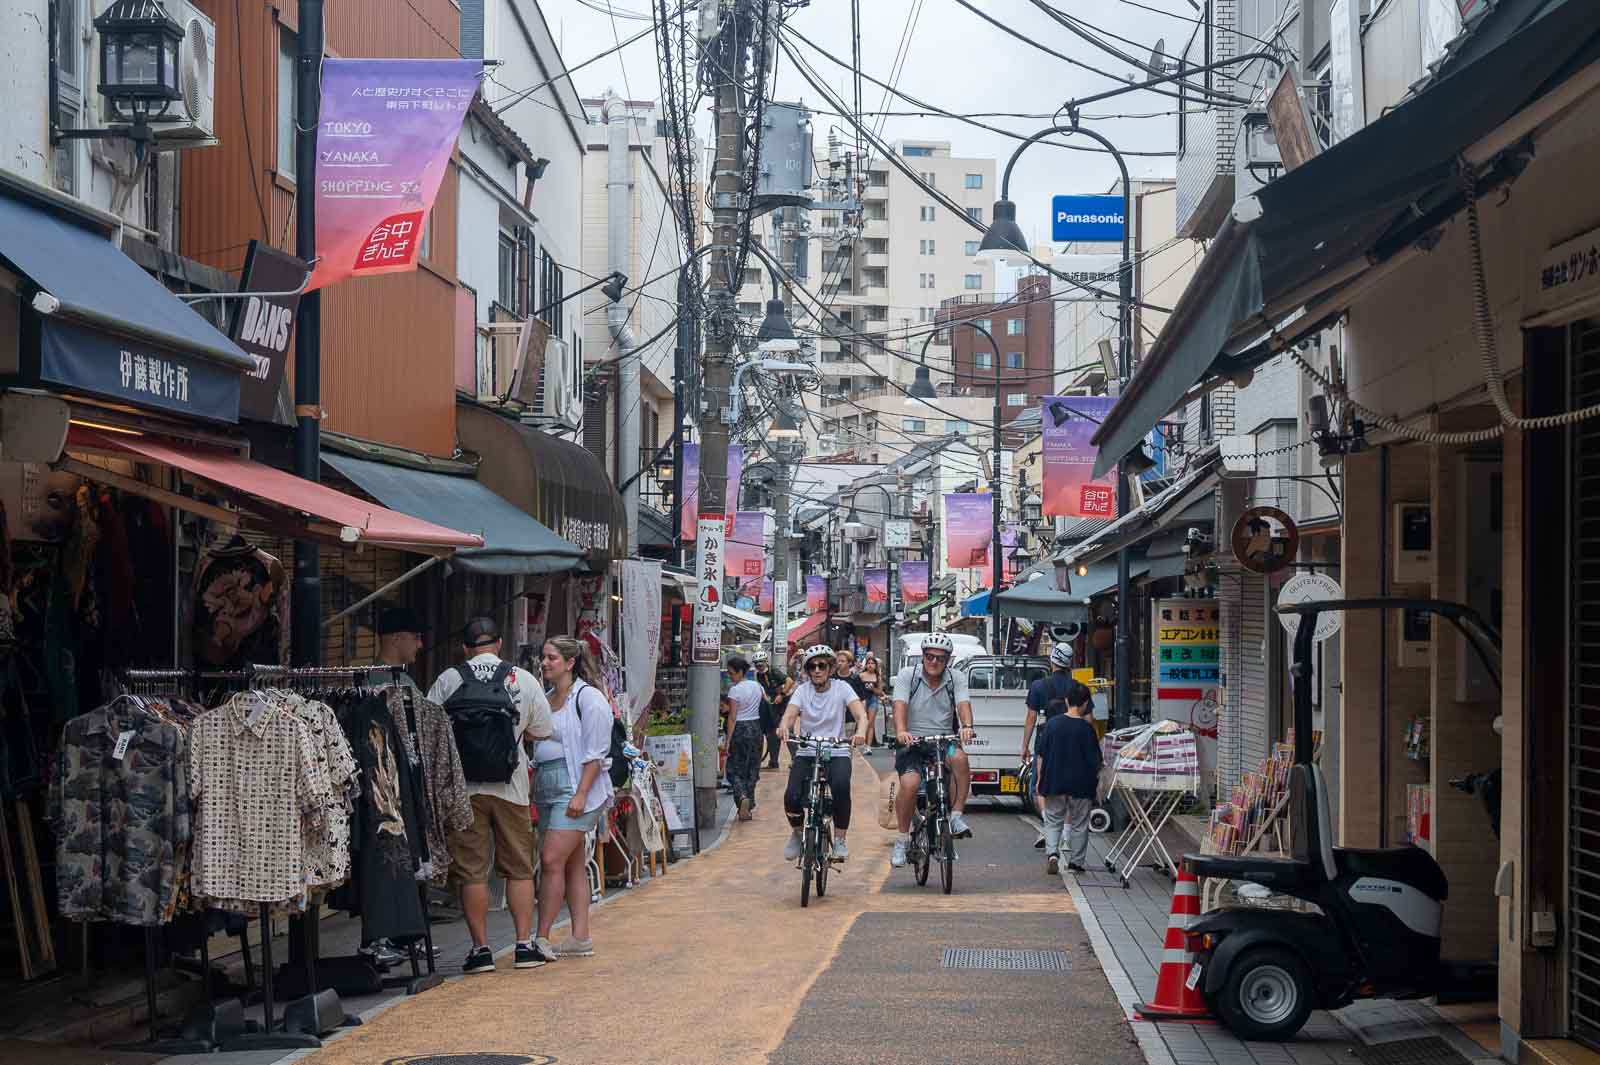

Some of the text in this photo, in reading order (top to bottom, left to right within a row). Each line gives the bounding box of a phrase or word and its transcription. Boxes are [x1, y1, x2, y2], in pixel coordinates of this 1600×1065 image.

[324, 122, 372, 134] TOKYO
[322, 151, 379, 162] YANAKA
[321, 180, 393, 193] SHOPPING
[1057, 211, 1125, 224] Panasonic
[370, 220, 413, 243] 谷中
[362, 239, 410, 262] ぎんざ
[241, 296, 292, 352] DANS
[119, 350, 189, 402] 伊藤製作所
[1084, 490, 1109, 500] 谷中
[1083, 501, 1109, 512] ぎんざ
[703, 536, 719, 581] かき氷
[1288, 578, 1317, 594] GLUTEN
